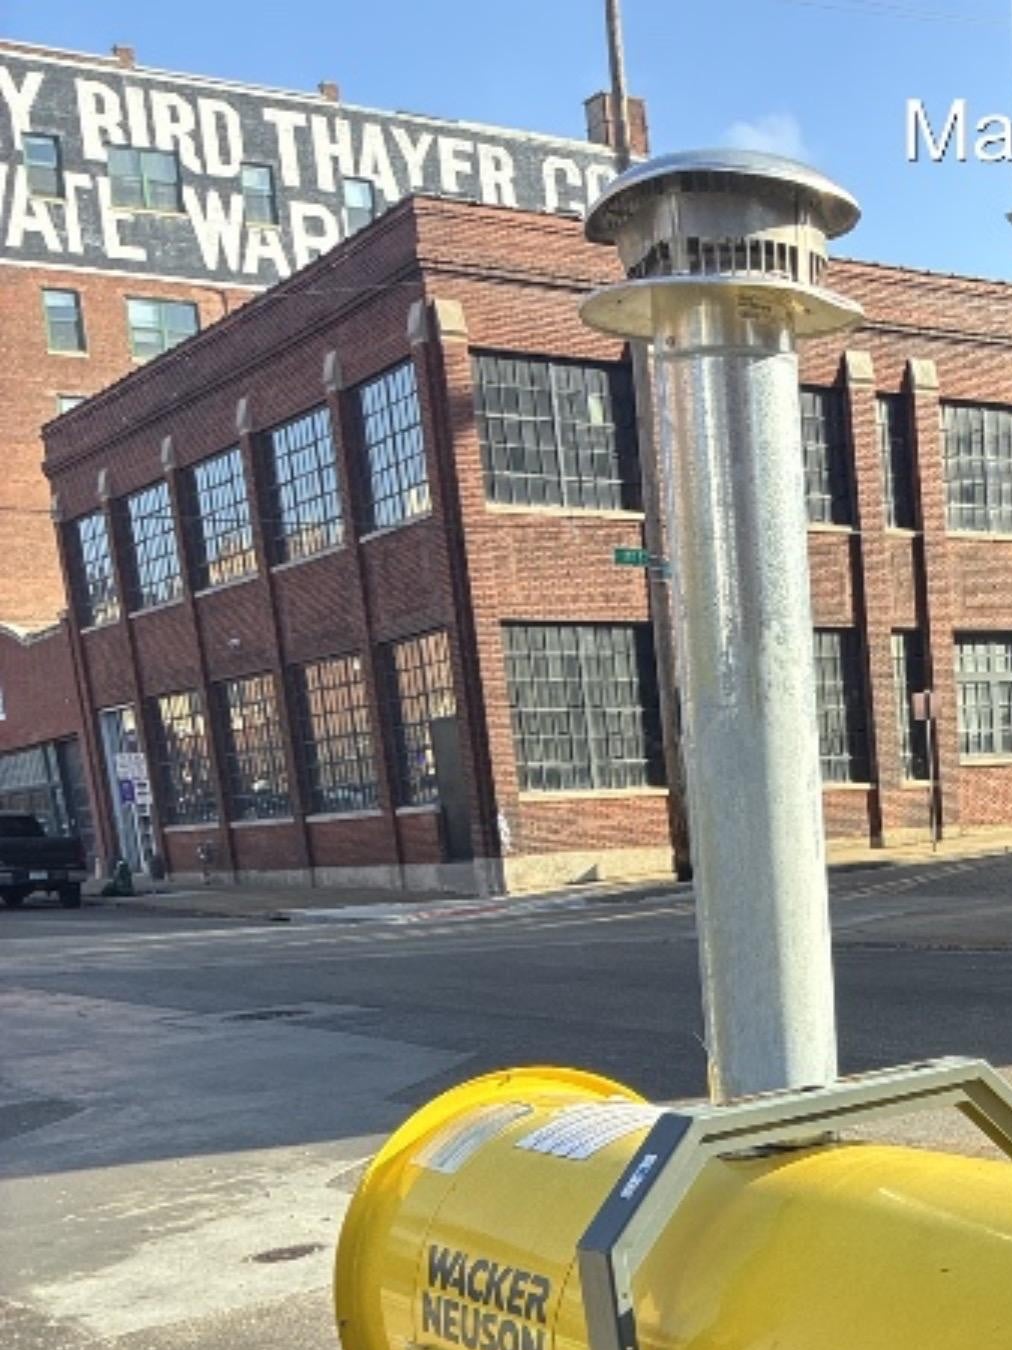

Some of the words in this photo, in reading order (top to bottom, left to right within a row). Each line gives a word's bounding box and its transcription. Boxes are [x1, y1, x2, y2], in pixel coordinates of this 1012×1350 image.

[262, 107, 519, 208] THAYER
[0, 163, 148, 262] ATE
[182, 184, 353, 279] WAR
[427, 1244, 550, 1325] WACKER
